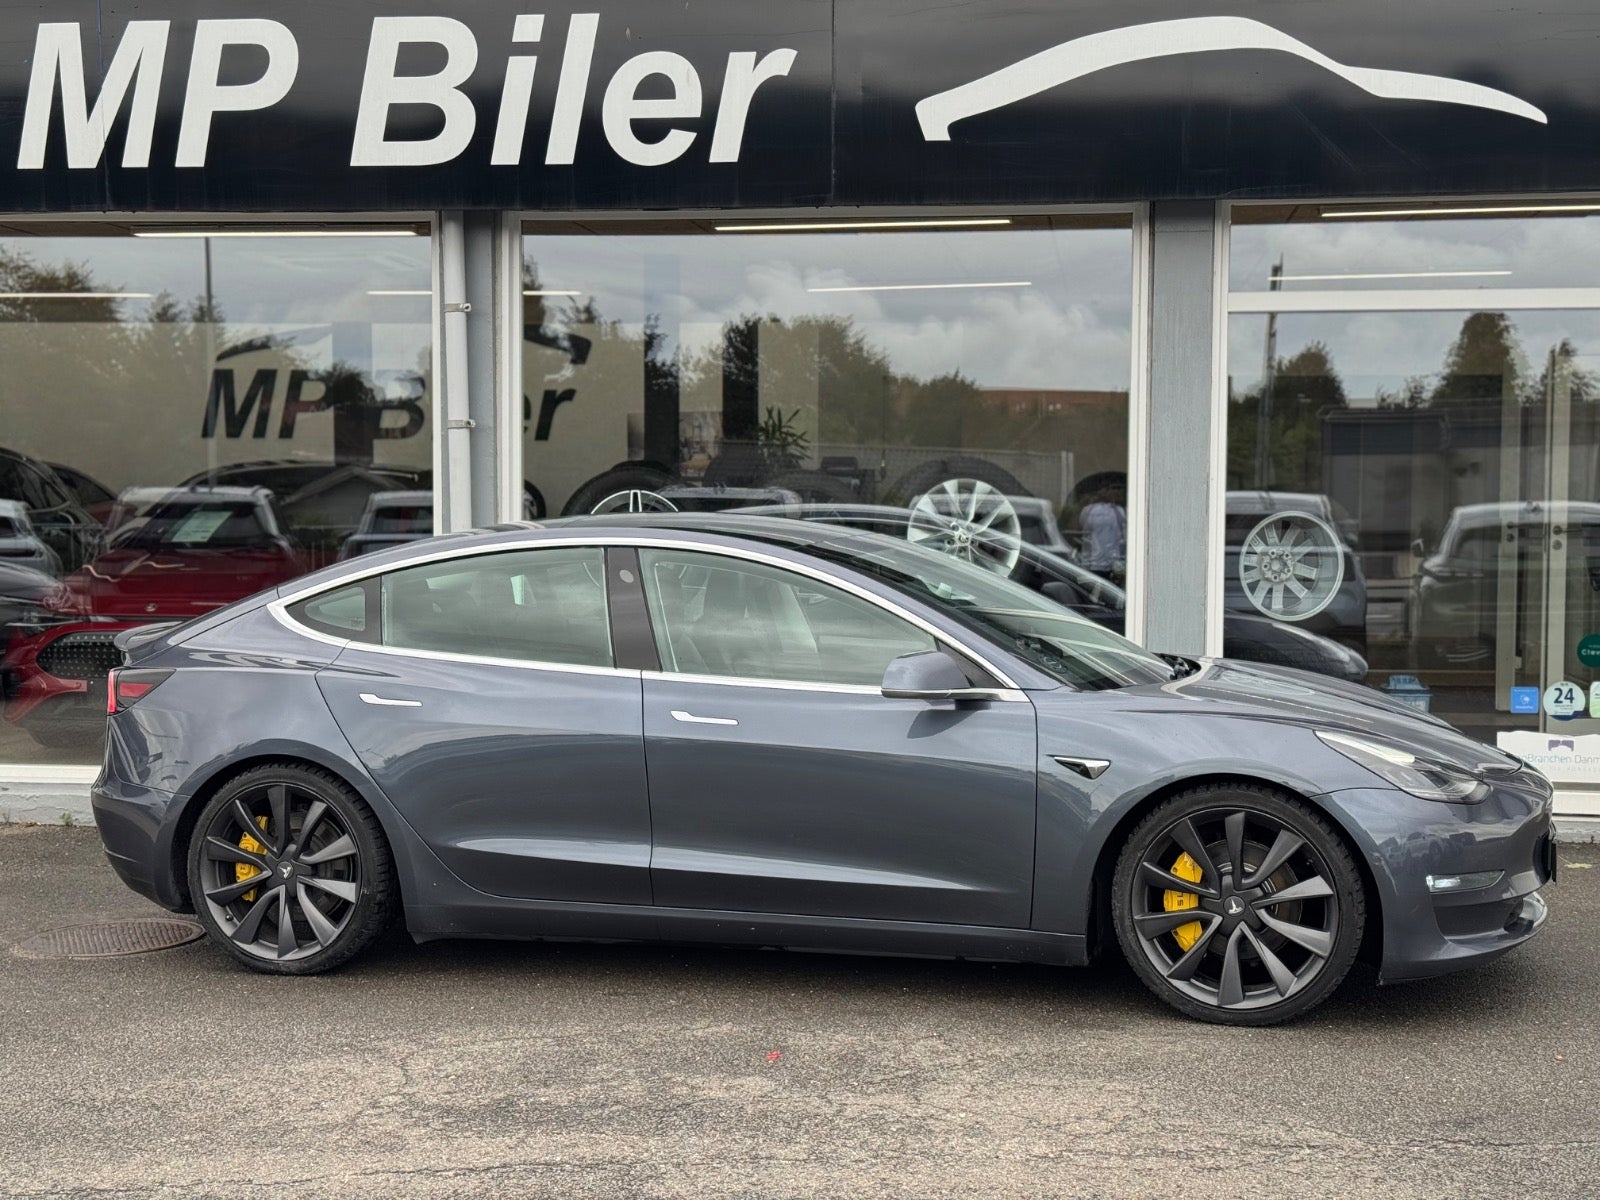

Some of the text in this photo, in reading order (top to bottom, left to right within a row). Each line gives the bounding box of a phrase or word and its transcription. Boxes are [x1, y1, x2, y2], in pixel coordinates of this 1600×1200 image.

[16, 13, 798, 169] MP Biler
[201, 369, 334, 439] MP
[1553, 687, 1575, 704] 24
